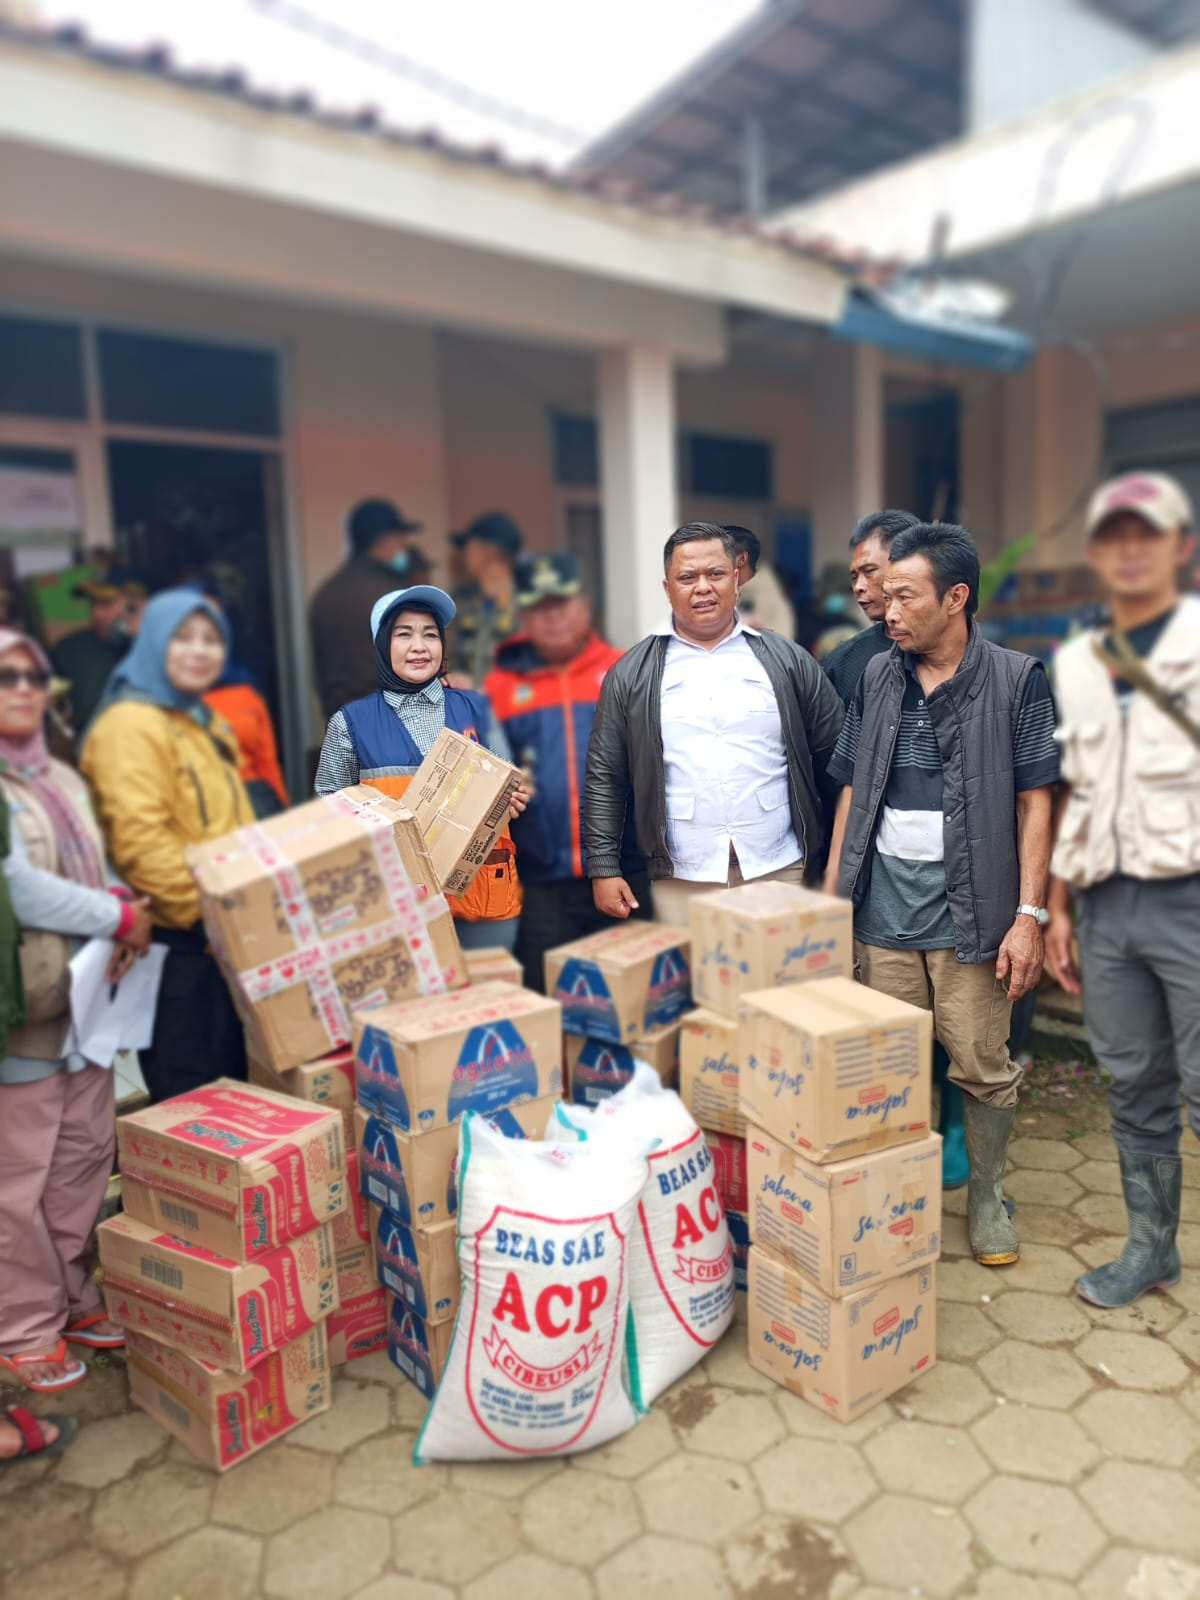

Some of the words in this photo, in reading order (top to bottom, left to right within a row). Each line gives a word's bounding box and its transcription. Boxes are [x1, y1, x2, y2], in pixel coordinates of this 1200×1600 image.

[657, 1158, 698, 1196] BEAS
[696, 1144, 712, 1173] SA
[495, 1228, 555, 1266] BEAS
[562, 1231, 605, 1266] SAE
[492, 1271, 608, 1339] ACP
[503, 1355, 581, 1387] CIBEUSI
